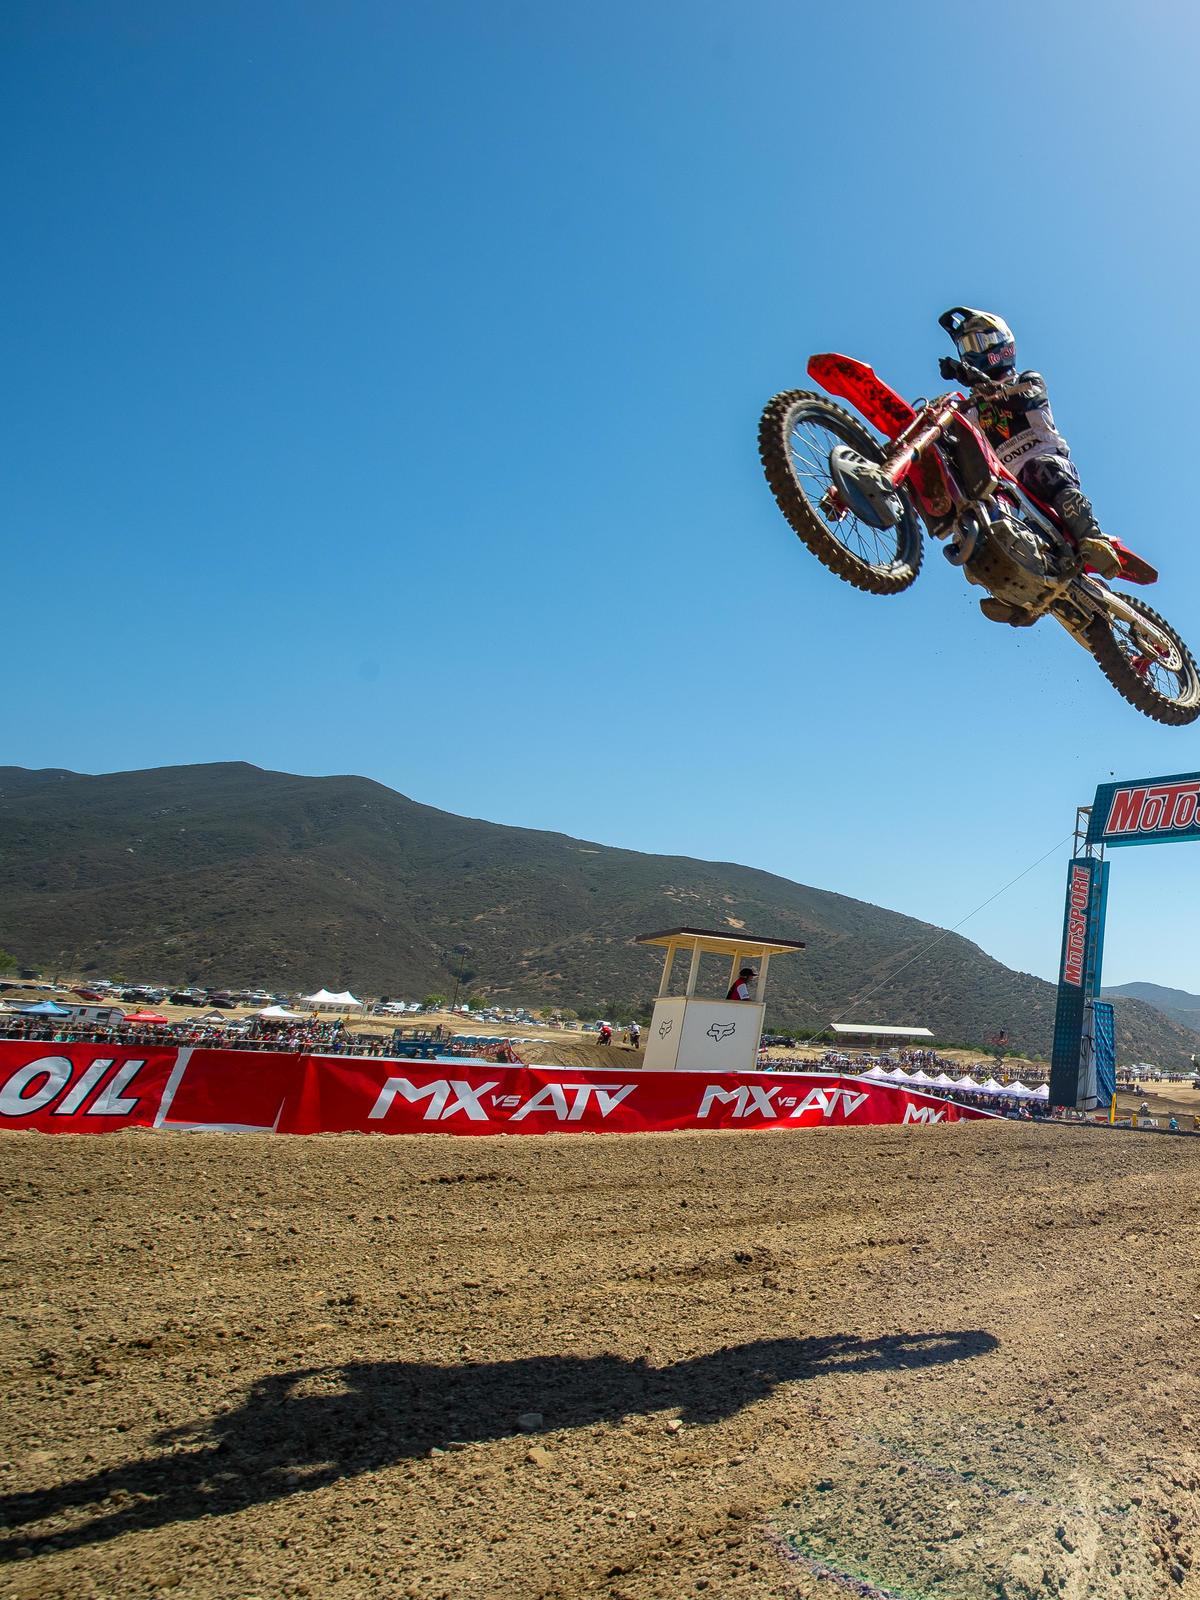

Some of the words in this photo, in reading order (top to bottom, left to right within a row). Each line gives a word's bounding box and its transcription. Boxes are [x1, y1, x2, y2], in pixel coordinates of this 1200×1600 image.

[0, 1056, 147, 1117] OIL
[367, 1077, 499, 1121] MX
[508, 1083, 639, 1121] ATV
[696, 1085, 783, 1118] MX
[789, 1088, 870, 1118] ATV
